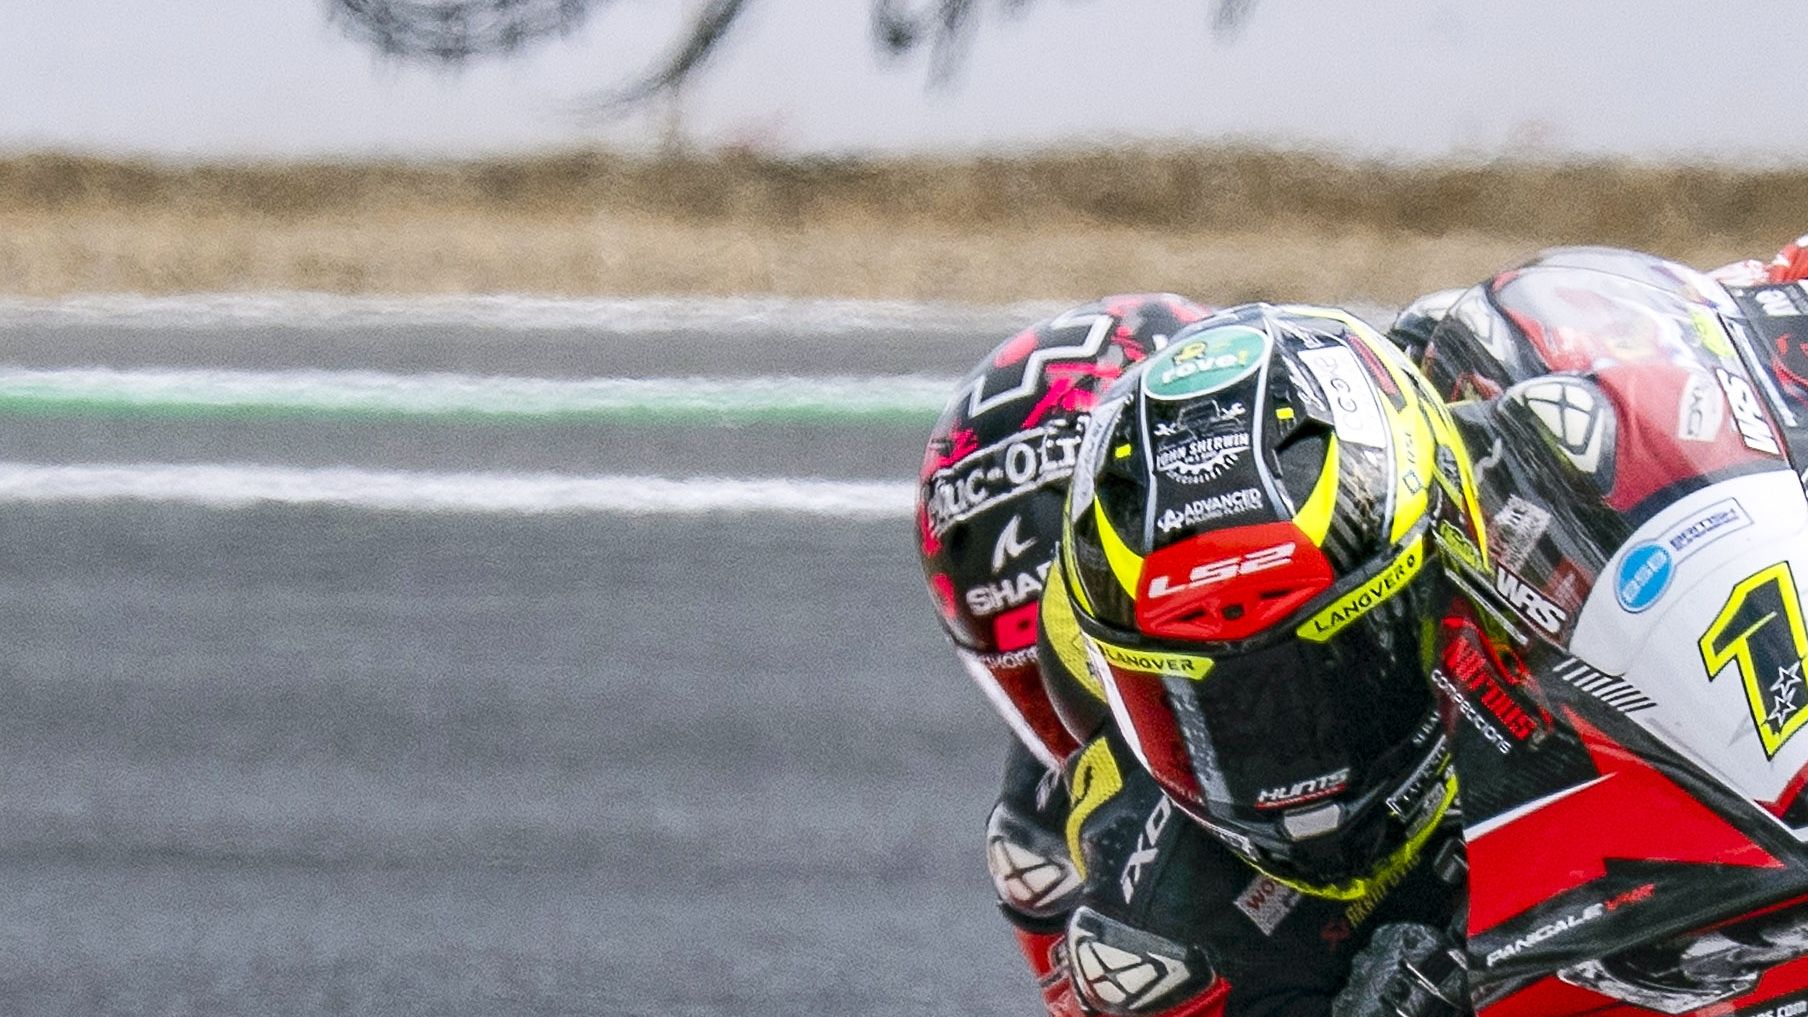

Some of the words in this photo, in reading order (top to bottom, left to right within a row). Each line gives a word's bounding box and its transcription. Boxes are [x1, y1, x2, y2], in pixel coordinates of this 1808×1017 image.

[1184, 487, 1262, 516] ADVANCED
[966, 560, 1053, 616] SHA
[1148, 541, 1297, 599] LS2
[1497, 566, 1567, 633] WRS
[1120, 794, 1172, 905] IXO
